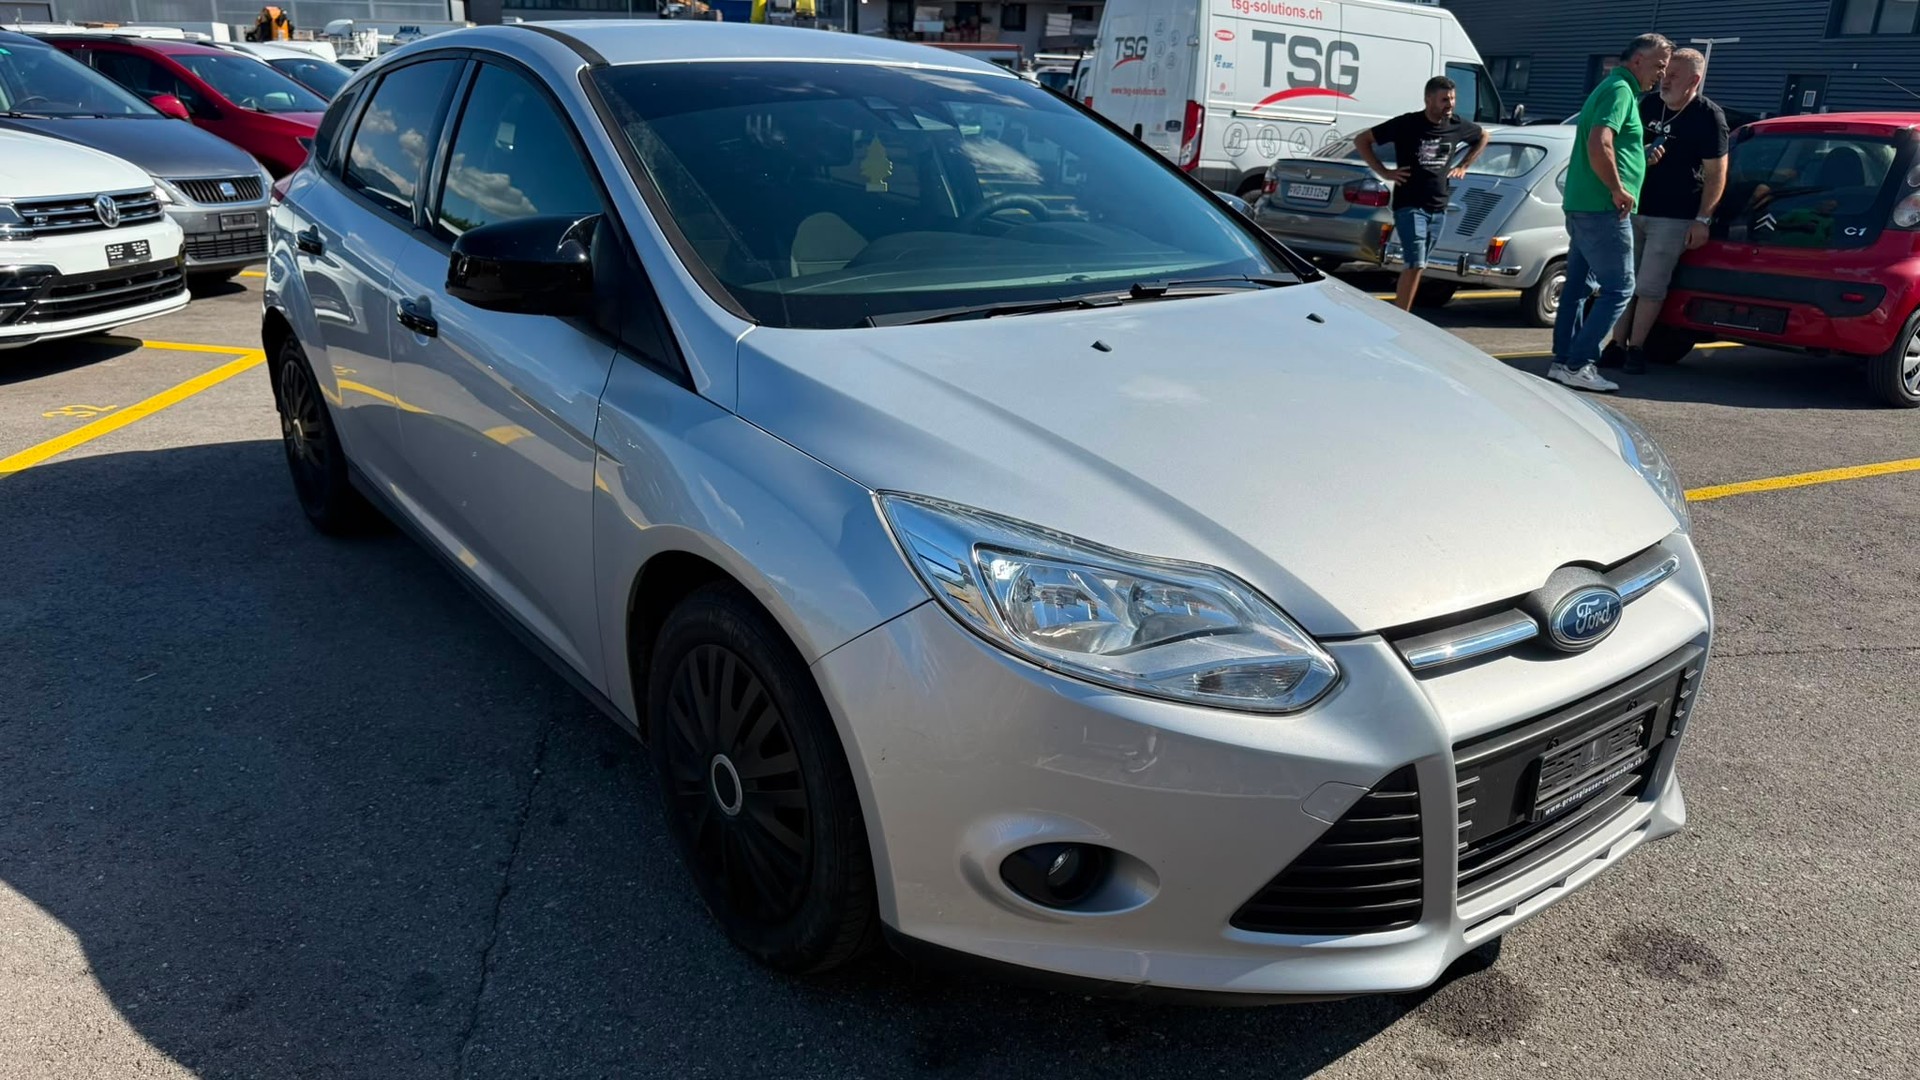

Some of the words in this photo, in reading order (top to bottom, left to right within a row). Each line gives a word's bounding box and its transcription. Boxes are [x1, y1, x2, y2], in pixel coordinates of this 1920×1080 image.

[1231, 0, 1322, 20] tsg-solutions.ch
[1115, 36, 1148, 60] TSG
[1252, 29, 1360, 96] TSG
[1844, 226, 1868, 236] C1
[1575, 598, 1612, 635] Ford
